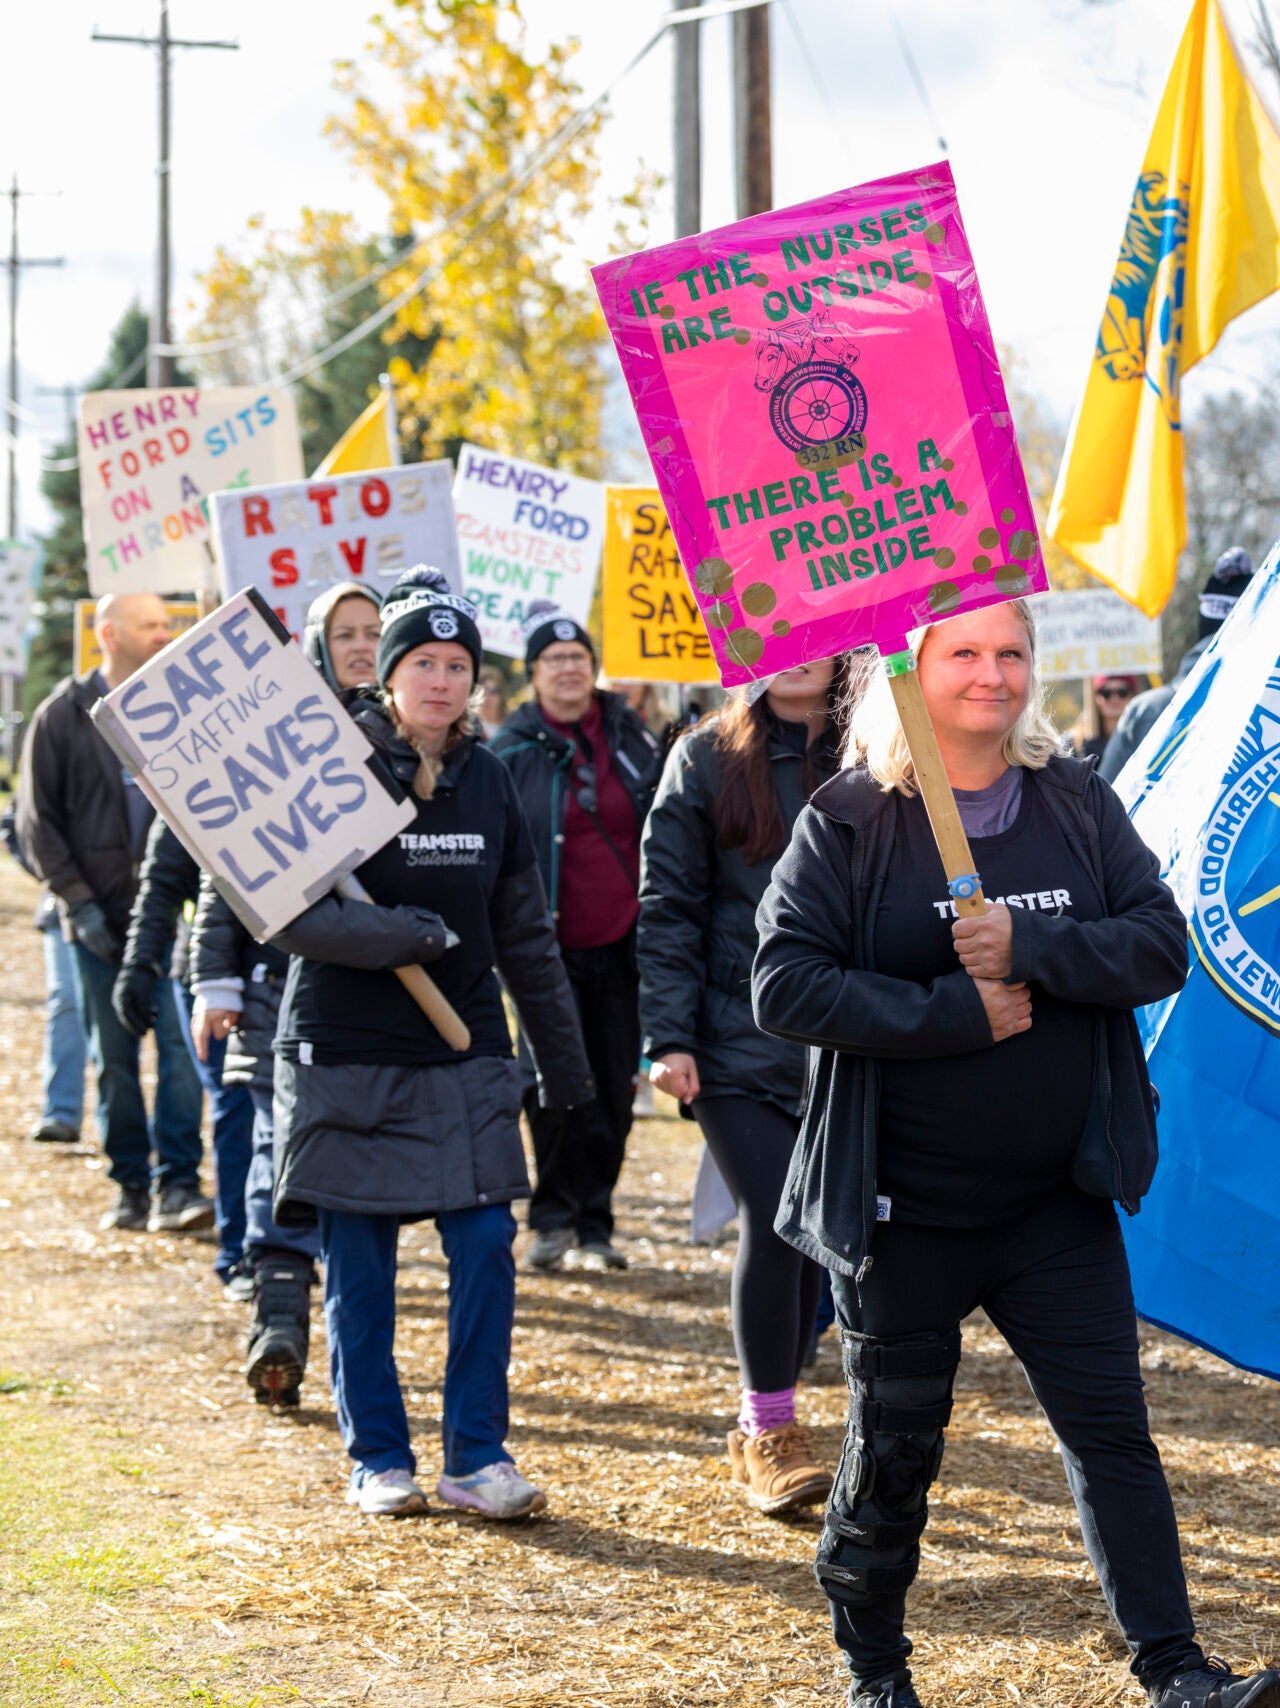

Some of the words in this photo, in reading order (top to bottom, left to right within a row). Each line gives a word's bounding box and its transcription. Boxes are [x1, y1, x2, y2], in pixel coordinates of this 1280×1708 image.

[630, 281, 665, 319] IF
[676, 251, 760, 301] THE
[780, 202, 929, 272] NURSES
[660, 306, 737, 354] ARE
[762, 250, 921, 322] OUTSIDE
[86, 390, 200, 449] HENRY
[781, 365, 837, 389] BROTHERHOOD
[854, 385, 864, 431] TEAMSTERS
[99, 427, 190, 489] FORD
[204, 396, 276, 457] SITS
[801, 445, 830, 465] 332
[834, 433, 863, 456] RN
[111, 485, 152, 522] ON
[179, 474, 199, 500] A
[241, 477, 426, 537] RATIOS
[465, 455, 569, 502] HENRY
[706, 467, 846, 530] THERE
[857, 453, 894, 491] IS
[917, 438, 943, 473] A
[455, 513, 582, 574] TEAMSTERS
[514, 500, 590, 541] FORD
[769, 478, 956, 562] PROBLEM
[269, 534, 404, 588] SAVE
[467, 549, 562, 594] WON'T
[628, 542, 682, 579] RAT
[806, 525, 936, 591] INSIDE
[465, 587, 524, 623] PEA
[628, 583, 699, 624] SAV
[120, 608, 271, 742] SAFE
[150, 674, 282, 789] STAFFING
[185, 695, 340, 830] SAVES
[219, 757, 367, 892] LIVES
[398, 833, 485, 850] TEAMSTER
[932, 888, 1073, 919] TSTER
